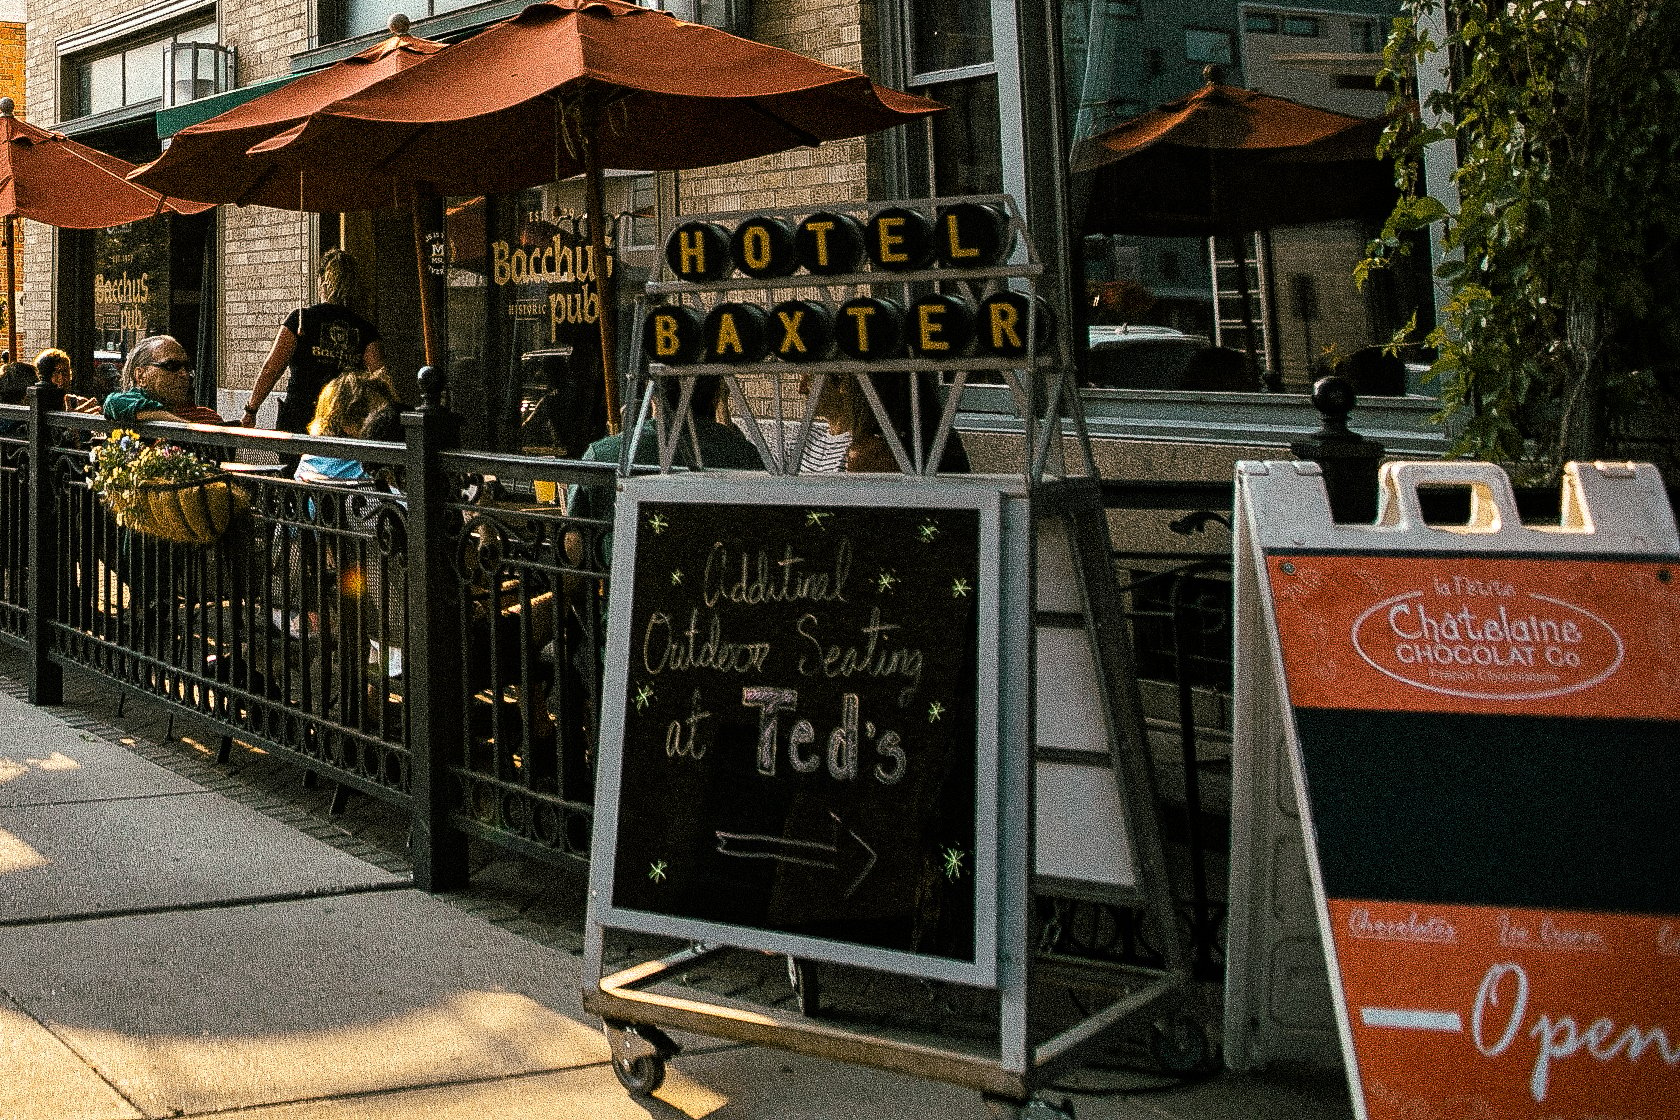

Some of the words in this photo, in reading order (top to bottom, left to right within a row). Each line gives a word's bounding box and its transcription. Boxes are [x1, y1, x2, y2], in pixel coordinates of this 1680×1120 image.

[679, 214, 980, 274] HOTEL
[549, 284, 601, 344] pub
[654, 302, 1022, 357] BAXTER
[1388, 602, 1582, 644] Châtelaine
[797, 607, 924, 707] Seating
[1395, 644, 1535, 667] CHOCOLAT
[1546, 646, 1582, 668] Co
[665, 688, 711, 761] at
[741, 686, 908, 785] Ted's
[1471, 963, 1680, 1103] Open
